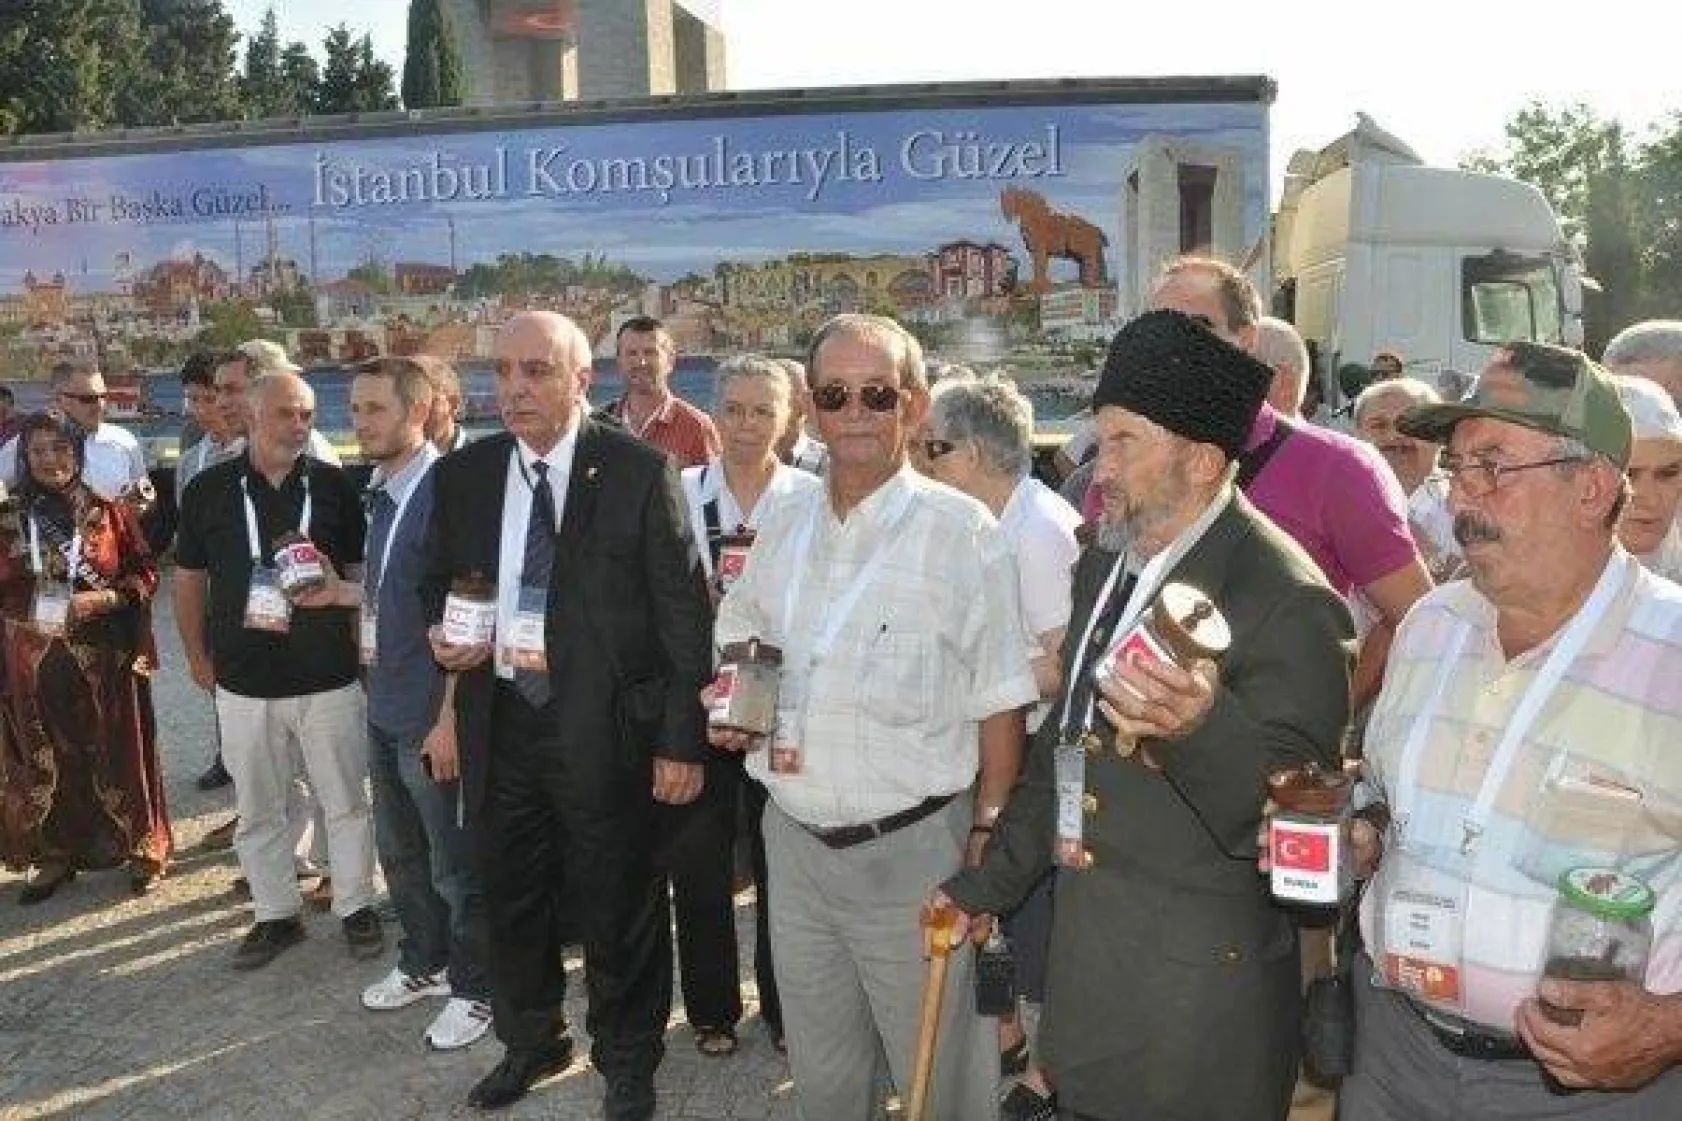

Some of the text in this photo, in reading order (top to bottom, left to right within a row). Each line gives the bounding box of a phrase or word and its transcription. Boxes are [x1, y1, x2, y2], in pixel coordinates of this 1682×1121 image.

[313, 123, 1062, 208] İstanbul Komşularıyla Güzel
[66, 196, 102, 224] Bir
[111, 189, 184, 227] Başka
